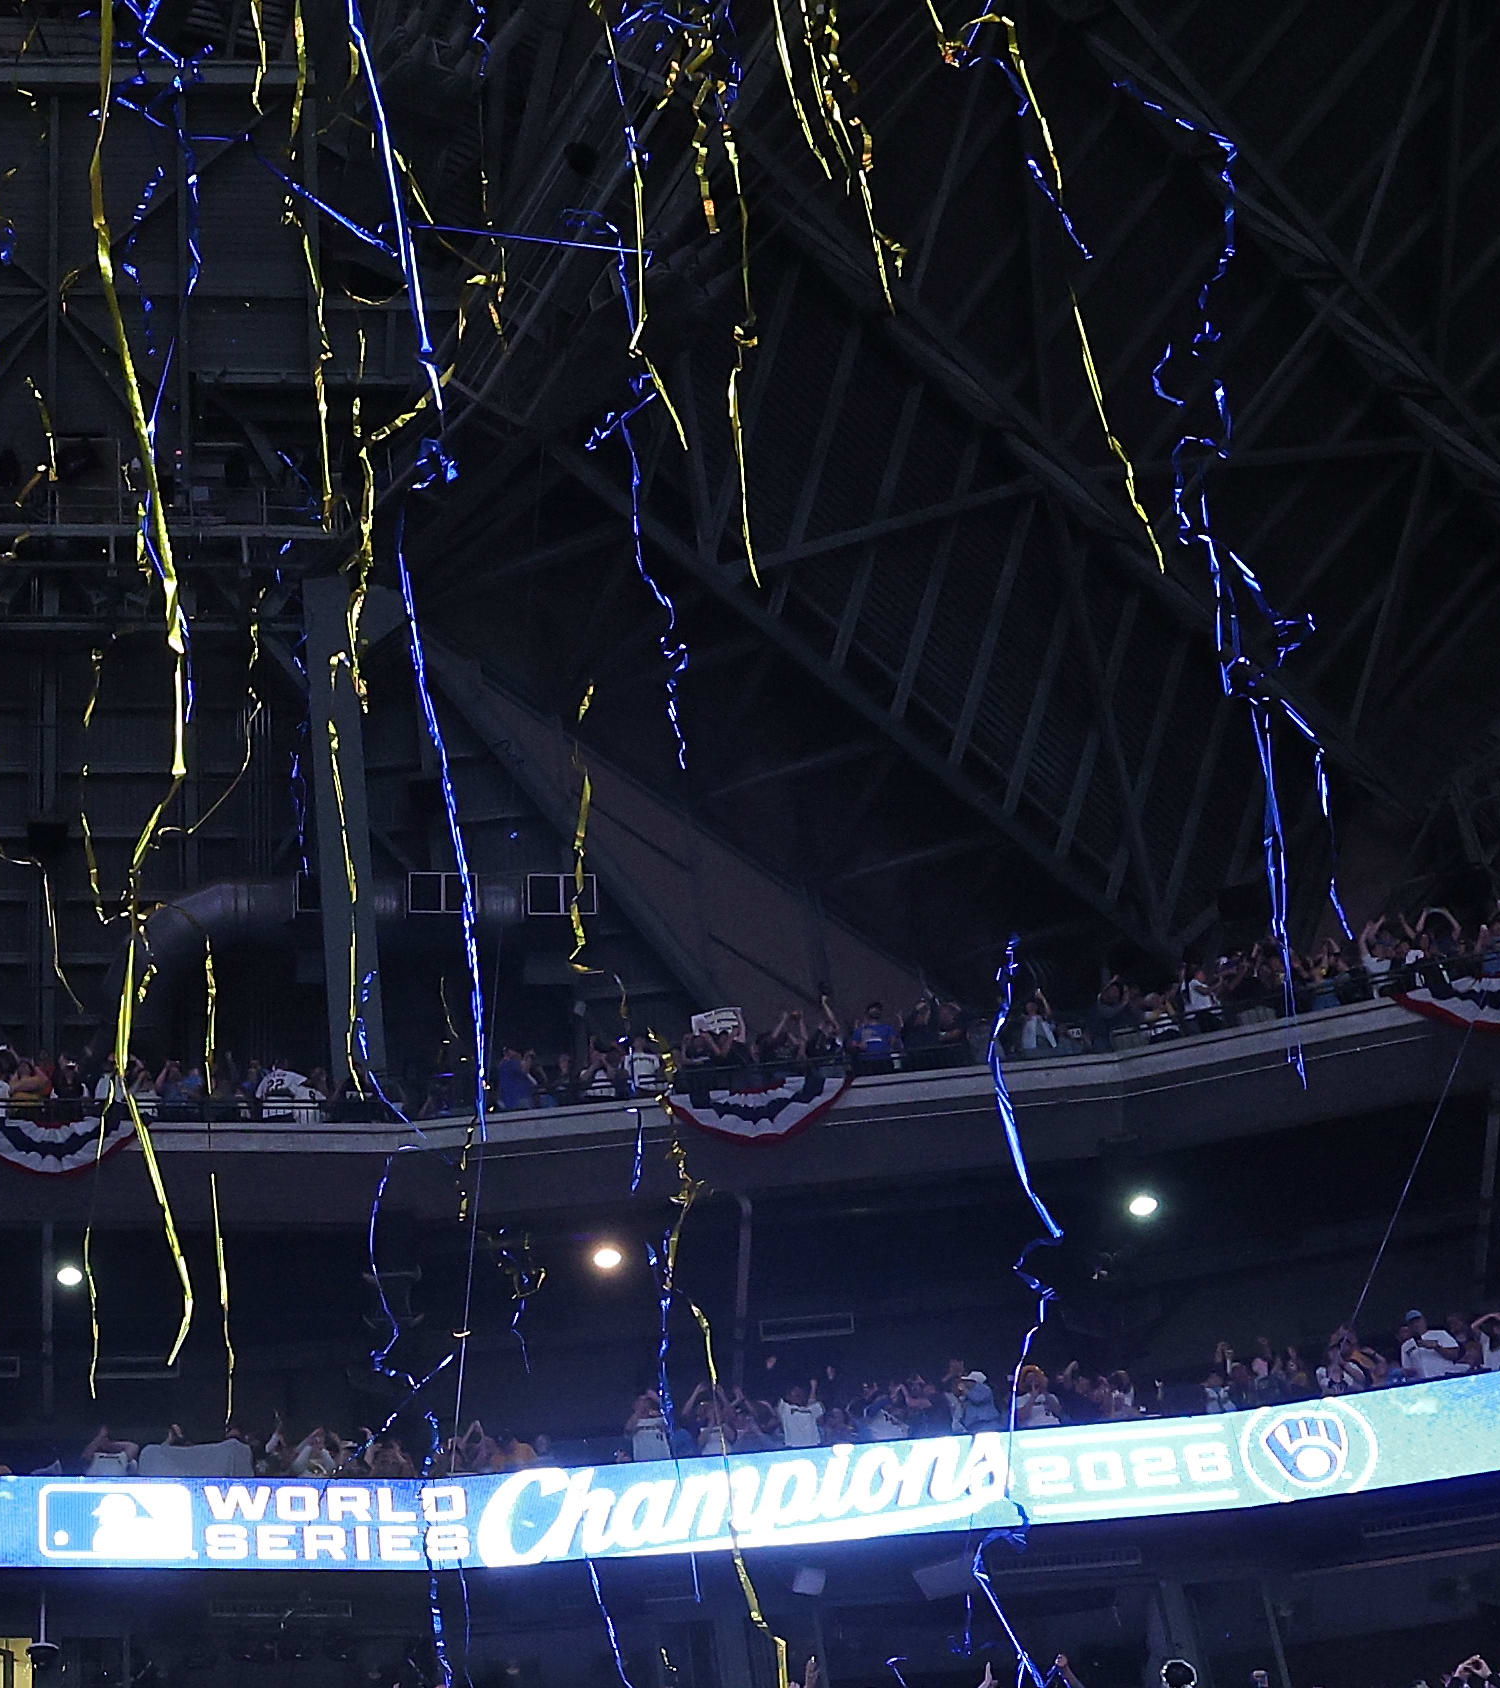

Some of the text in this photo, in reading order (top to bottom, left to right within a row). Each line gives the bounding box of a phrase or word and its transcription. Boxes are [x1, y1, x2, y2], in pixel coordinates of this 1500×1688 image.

[1025, 1442, 1233, 1496] 2026
[204, 1485, 467, 1522] WORLD
[478, 1431, 1003, 1566] Champions
[204, 1525, 470, 1562] SERIES
